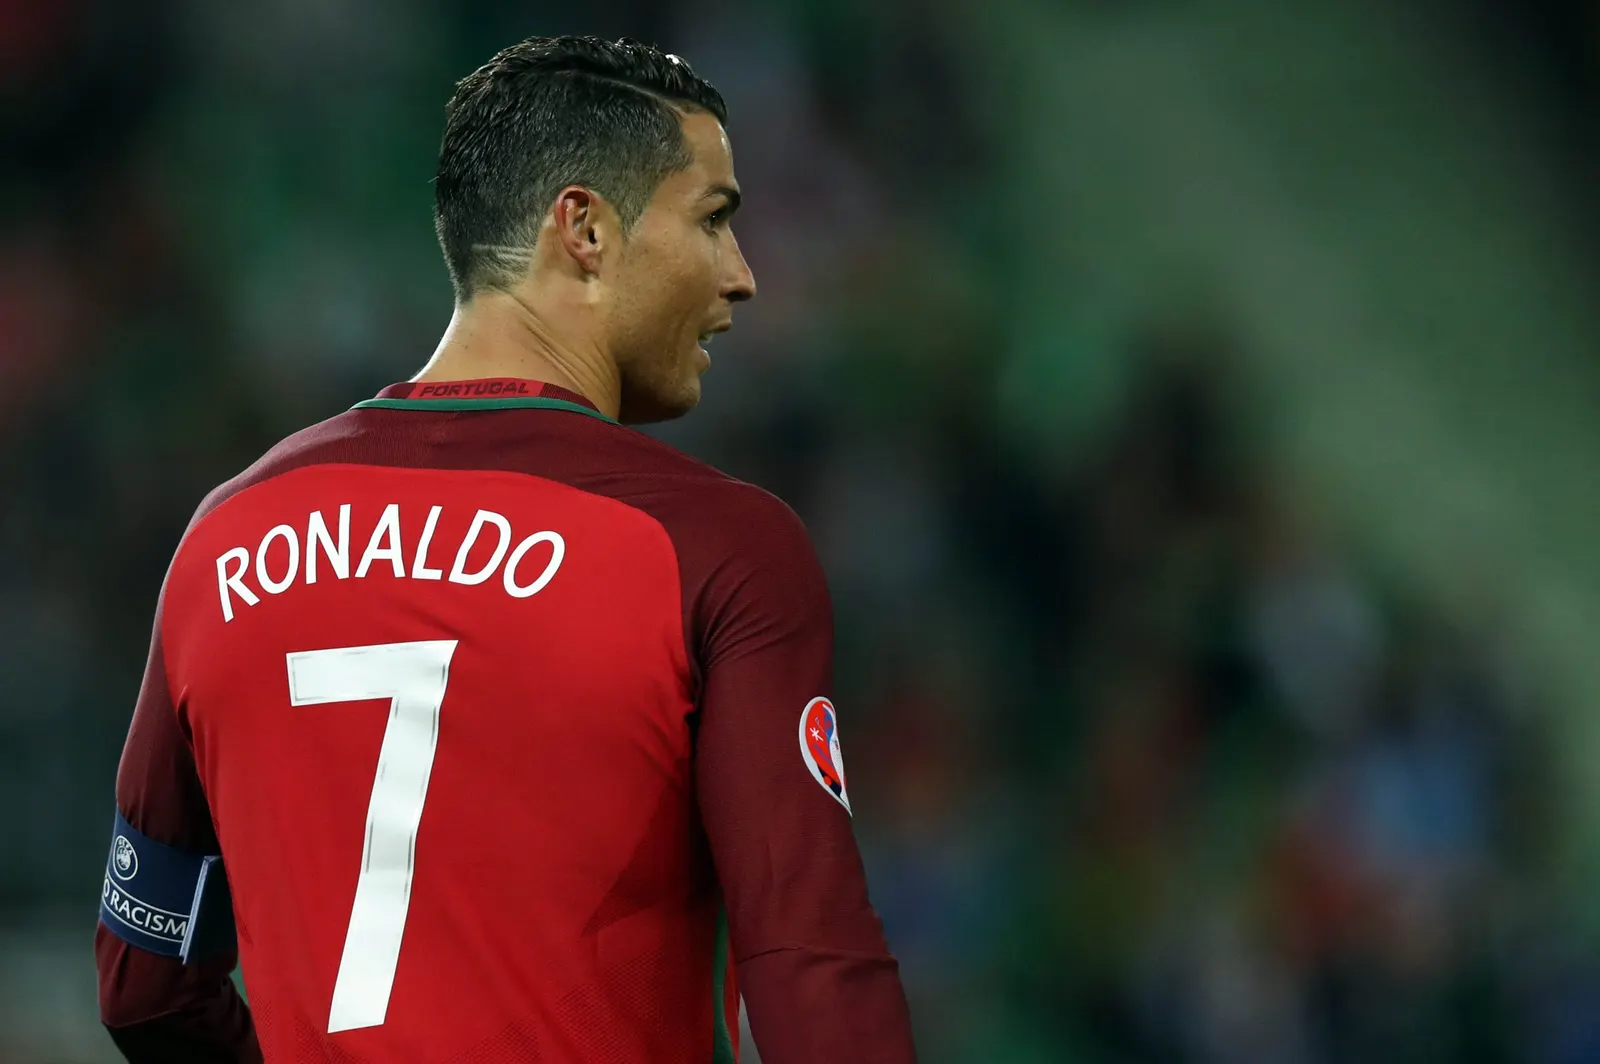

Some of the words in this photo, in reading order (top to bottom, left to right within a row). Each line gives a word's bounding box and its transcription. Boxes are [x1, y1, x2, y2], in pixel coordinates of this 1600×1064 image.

[419, 381, 529, 397] PORTUGAL
[215, 503, 566, 623] RONALDO
[286, 640, 458, 1034] 7
[110, 889, 188, 937] RACISM
